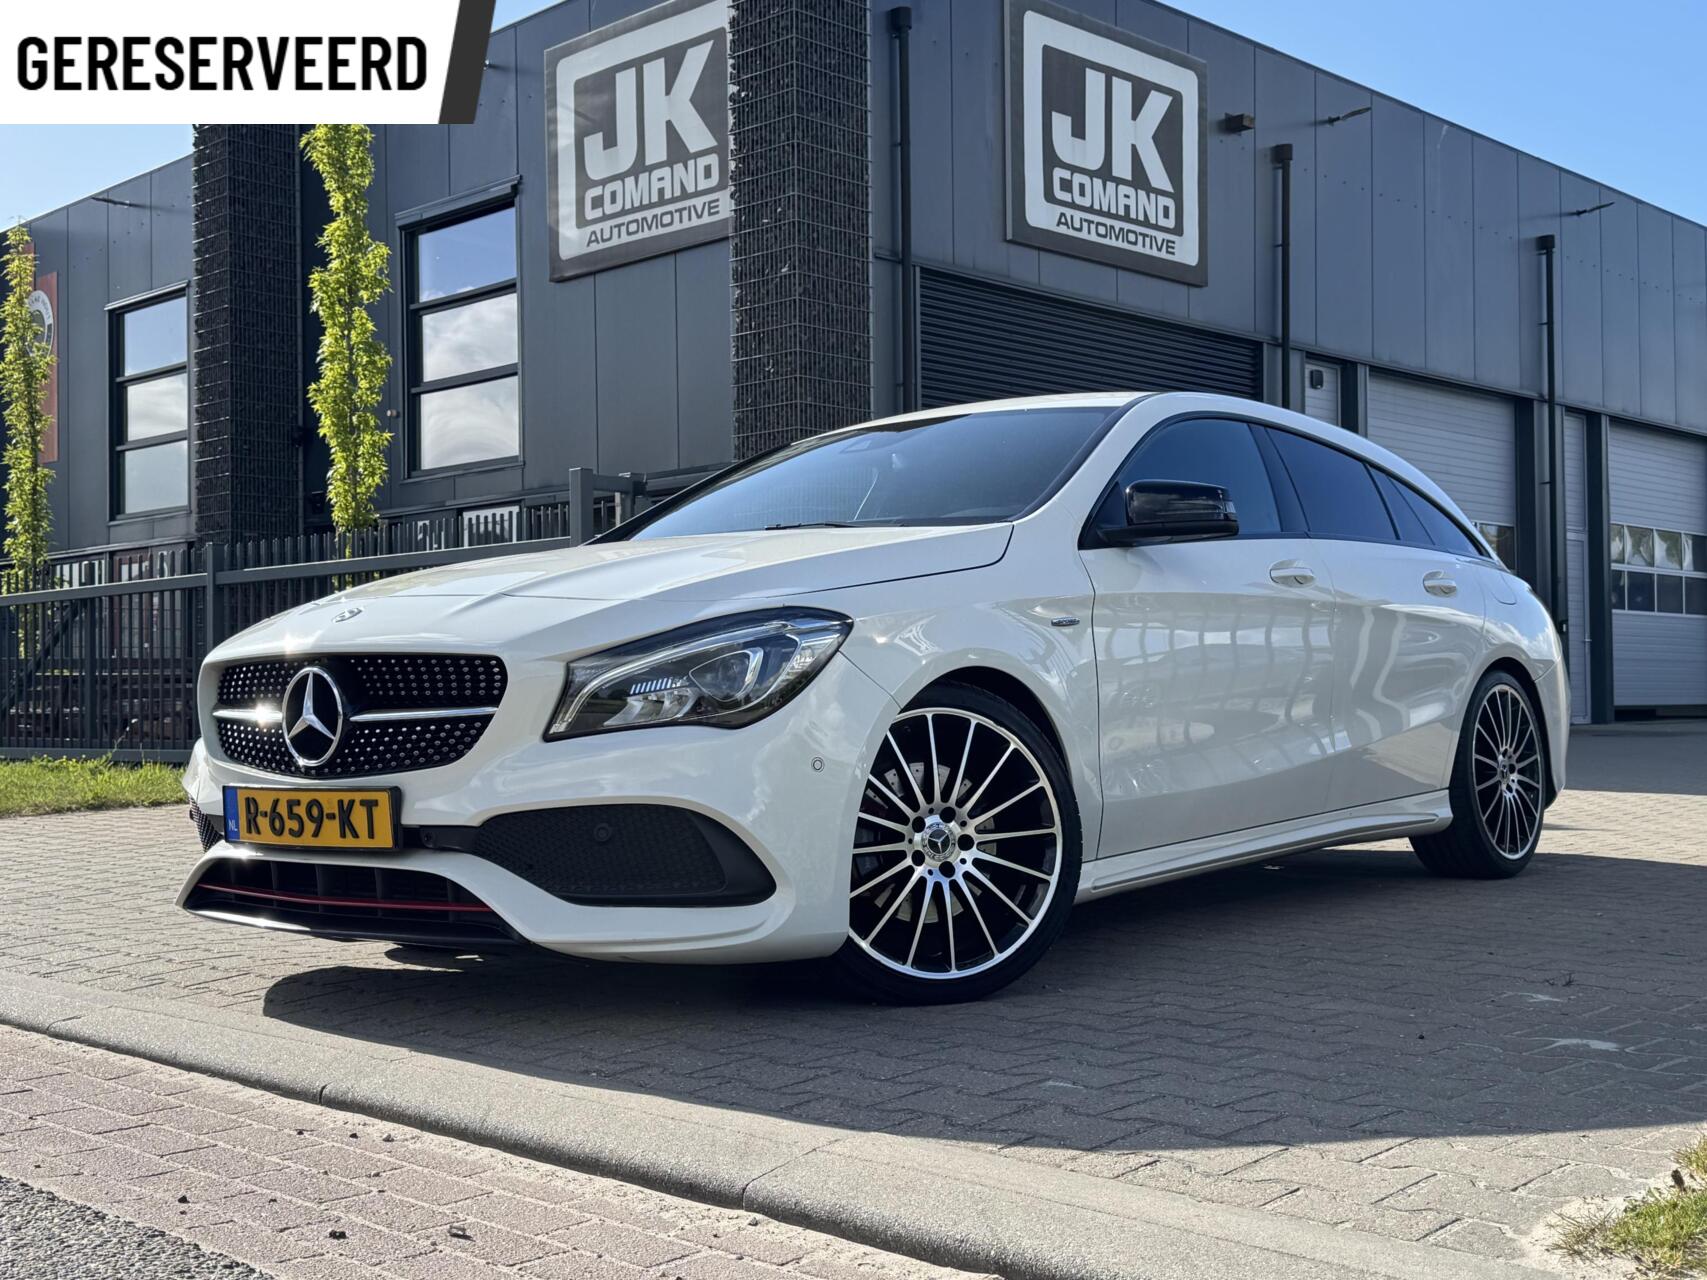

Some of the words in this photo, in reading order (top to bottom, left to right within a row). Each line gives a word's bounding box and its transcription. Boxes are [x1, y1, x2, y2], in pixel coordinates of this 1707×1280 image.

[583, 39, 719, 181] JK
[1051, 67, 1175, 194] JK
[584, 153, 720, 221] COMAND
[1052, 166, 1176, 230] COMAND
[586, 198, 721, 248] AUTOMOTIVE
[1056, 211, 1176, 256] AUTOMOTIVE
[228, 819, 239, 832] NL
[244, 796, 379, 840] R-659-KT
